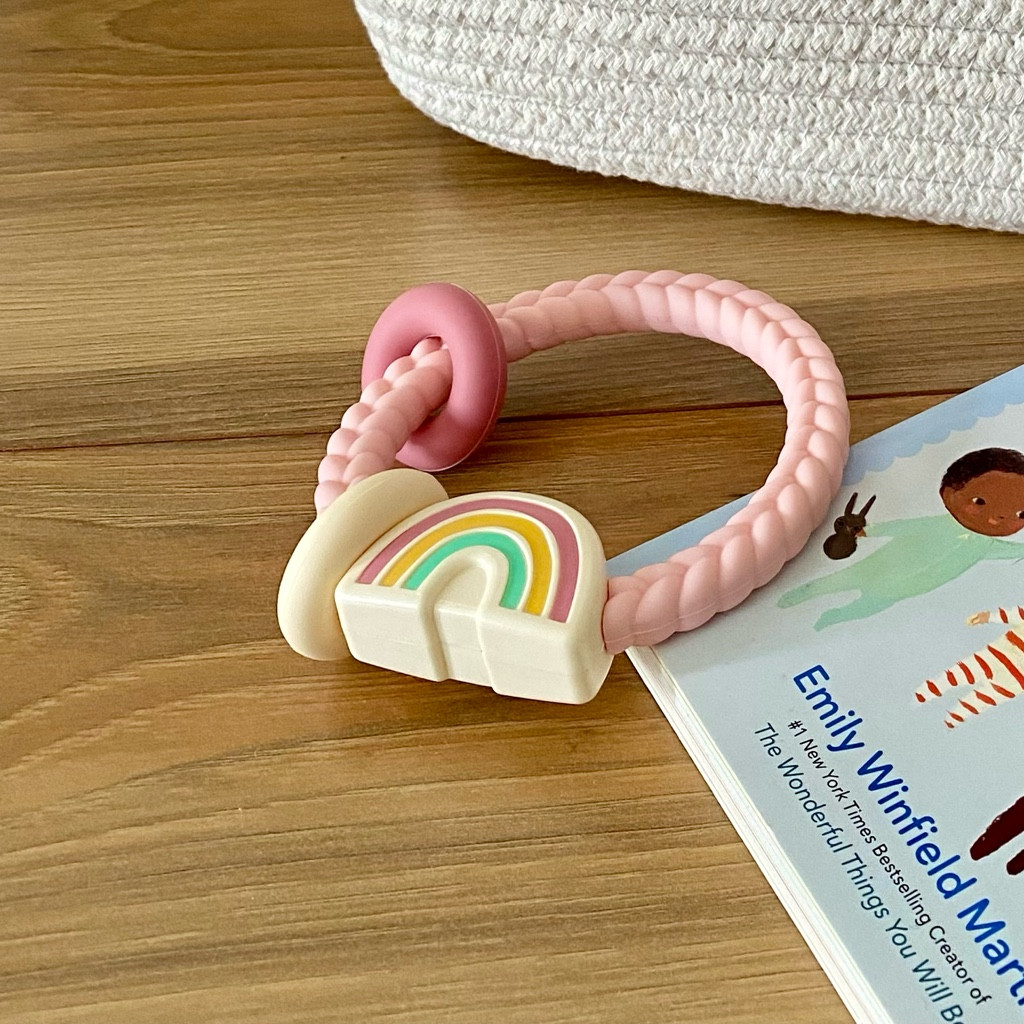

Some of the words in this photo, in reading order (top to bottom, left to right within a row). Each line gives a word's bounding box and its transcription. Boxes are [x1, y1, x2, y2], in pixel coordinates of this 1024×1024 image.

[754, 722, 781, 757] The
[777, 757, 852, 853] Wonderful
[841, 852, 890, 919] Things
[885, 918, 917, 959] You
[912, 959, 953, 1003] Will
[787, 719, 808, 737] #1
[799, 739, 827, 770] New
[822, 769, 850, 802] York
[842, 800, 877, 844] Times
[872, 843, 931, 927] Bestselling
[928, 925, 973, 988] Creator
[970, 984, 992, 1005] of
[793, 664, 865, 753] Emily
[857, 750, 977, 899] Winfield
